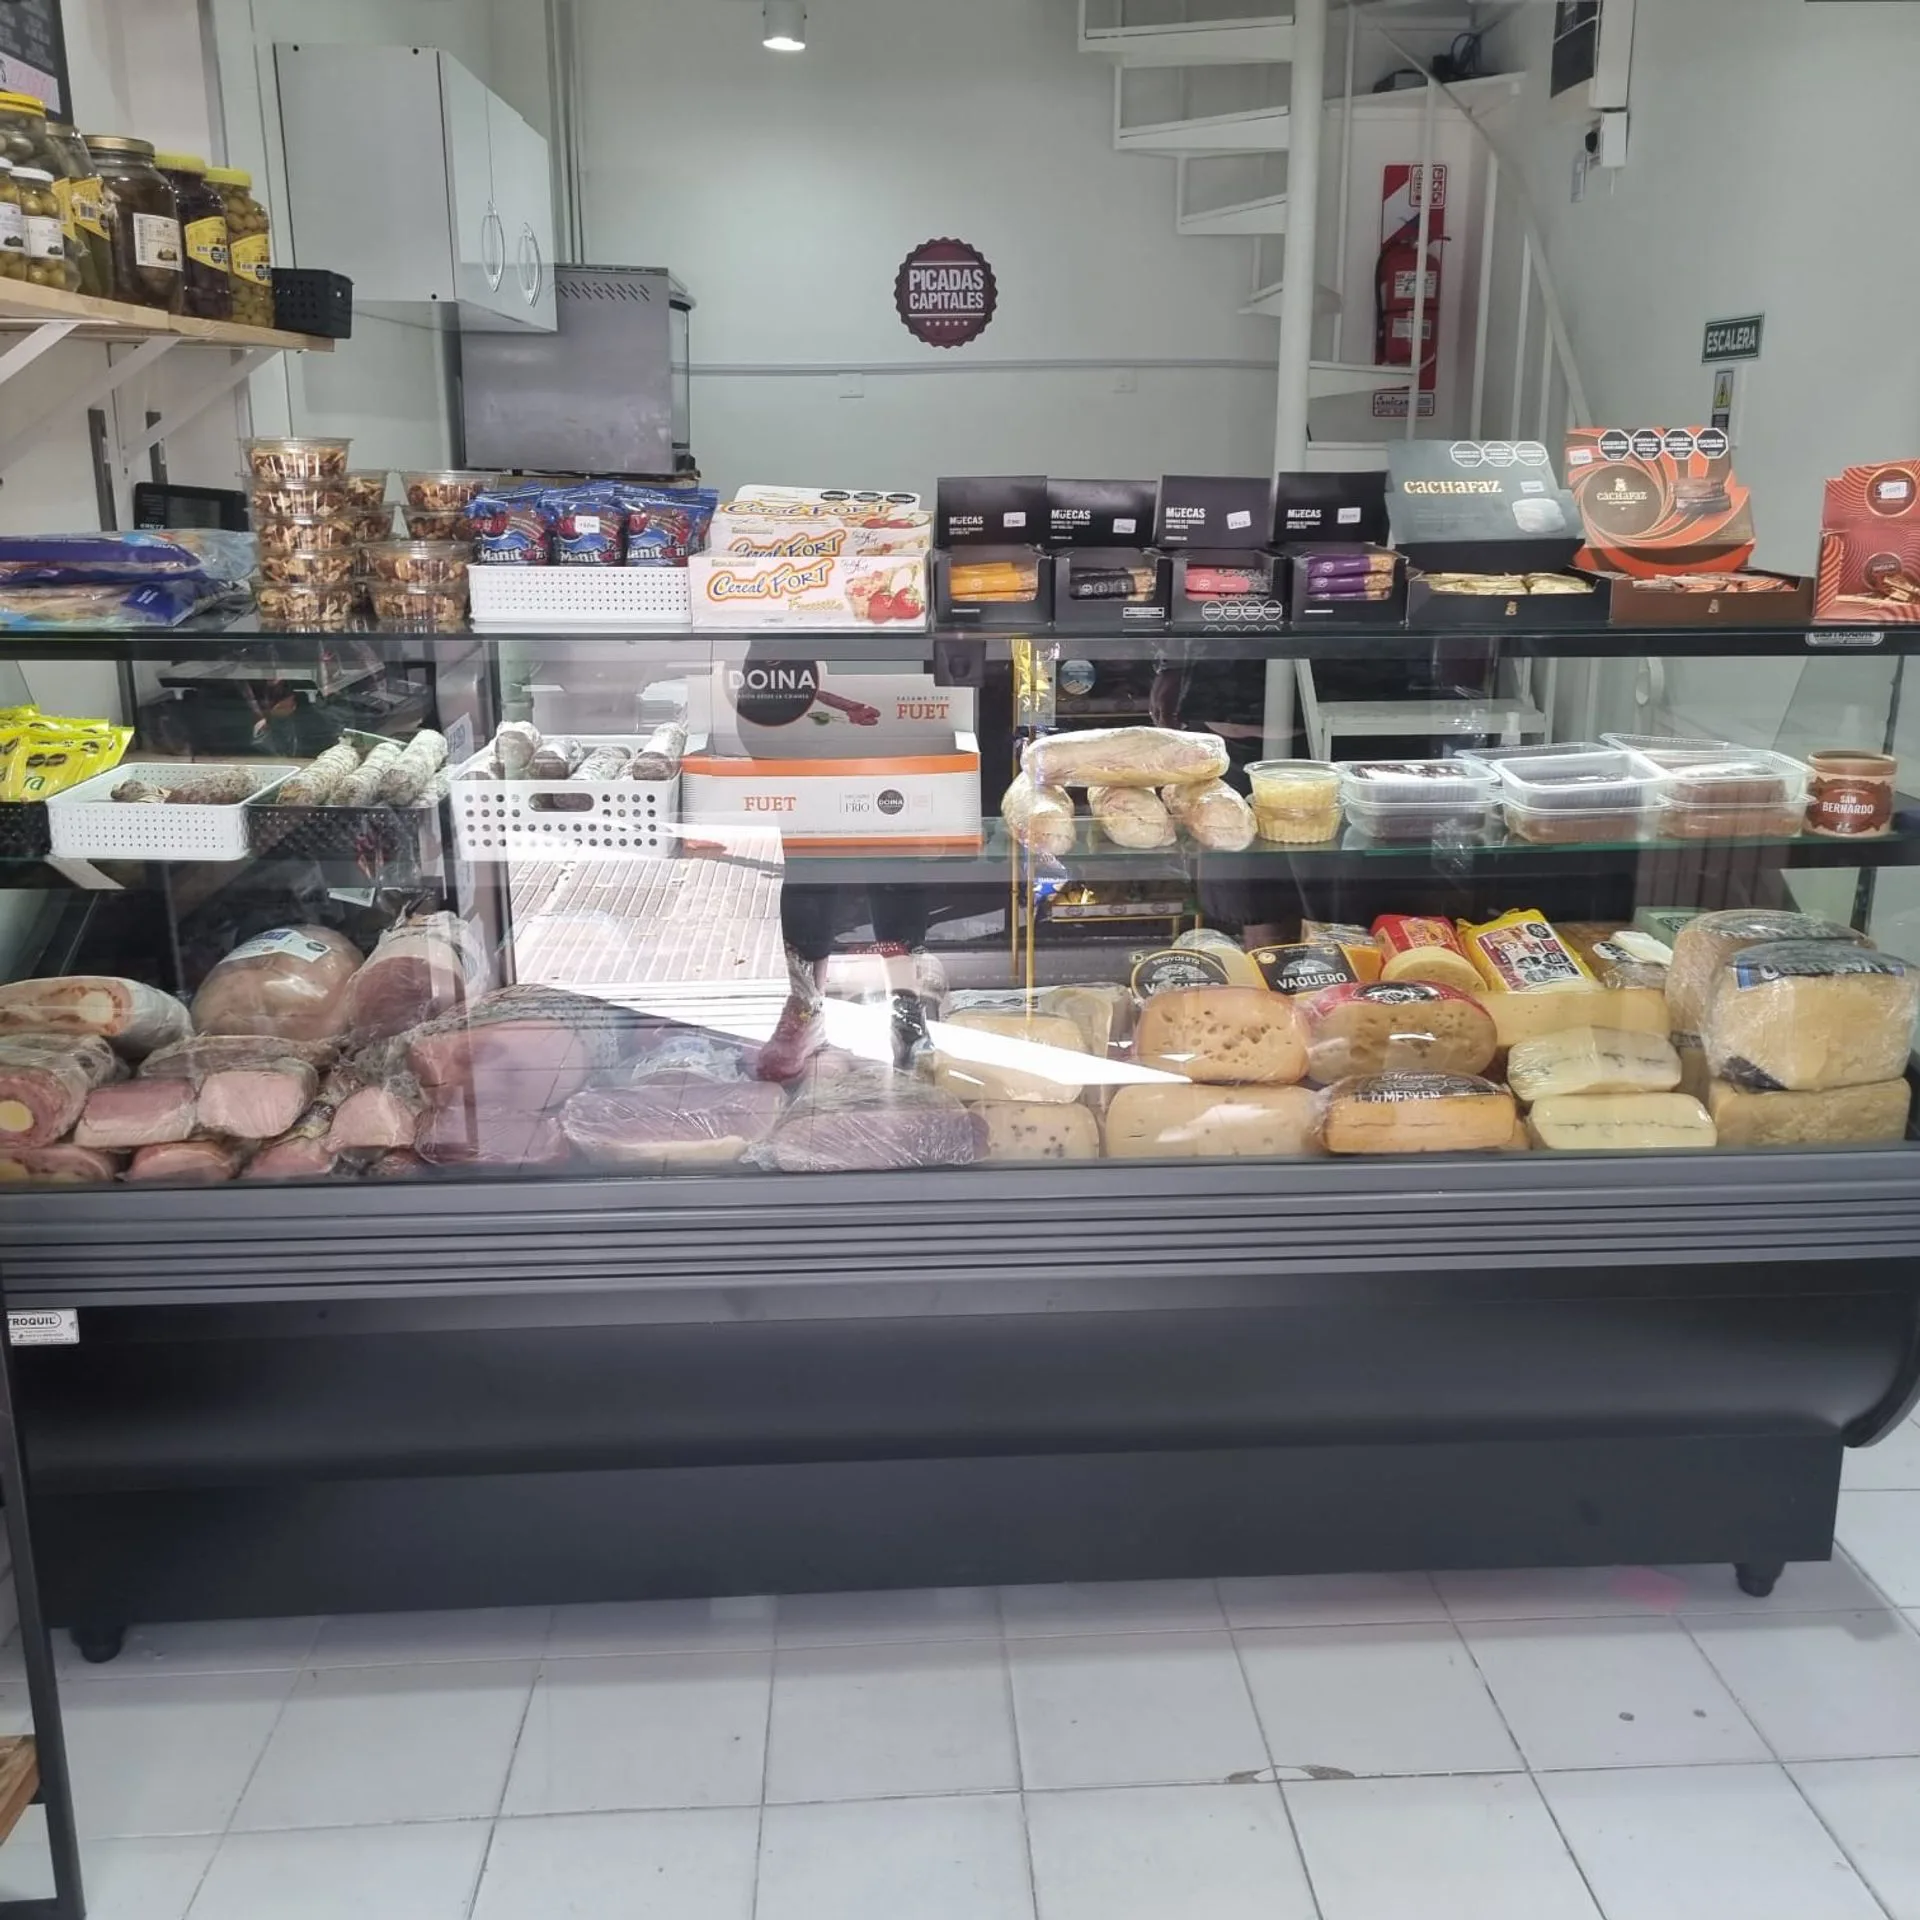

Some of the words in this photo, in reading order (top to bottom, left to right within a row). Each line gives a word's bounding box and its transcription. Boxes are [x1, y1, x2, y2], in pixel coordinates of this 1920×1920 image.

[908, 269, 985, 291] PICADAS
[909, 292, 985, 310] CAPITALES
[1706, 325, 1757, 353] ESCALERA
[713, 576, 765, 596] Cereal
[770, 564, 829, 592] FORT
[729, 669, 817, 690] DOINA
[896, 704, 949, 720] FUET
[743, 796, 797, 811] FUET
[1822, 802, 1874, 814] BERNARDO
[1840, 795, 1857, 804] SAN
[1277, 972, 1348, 989] VAQUERO
